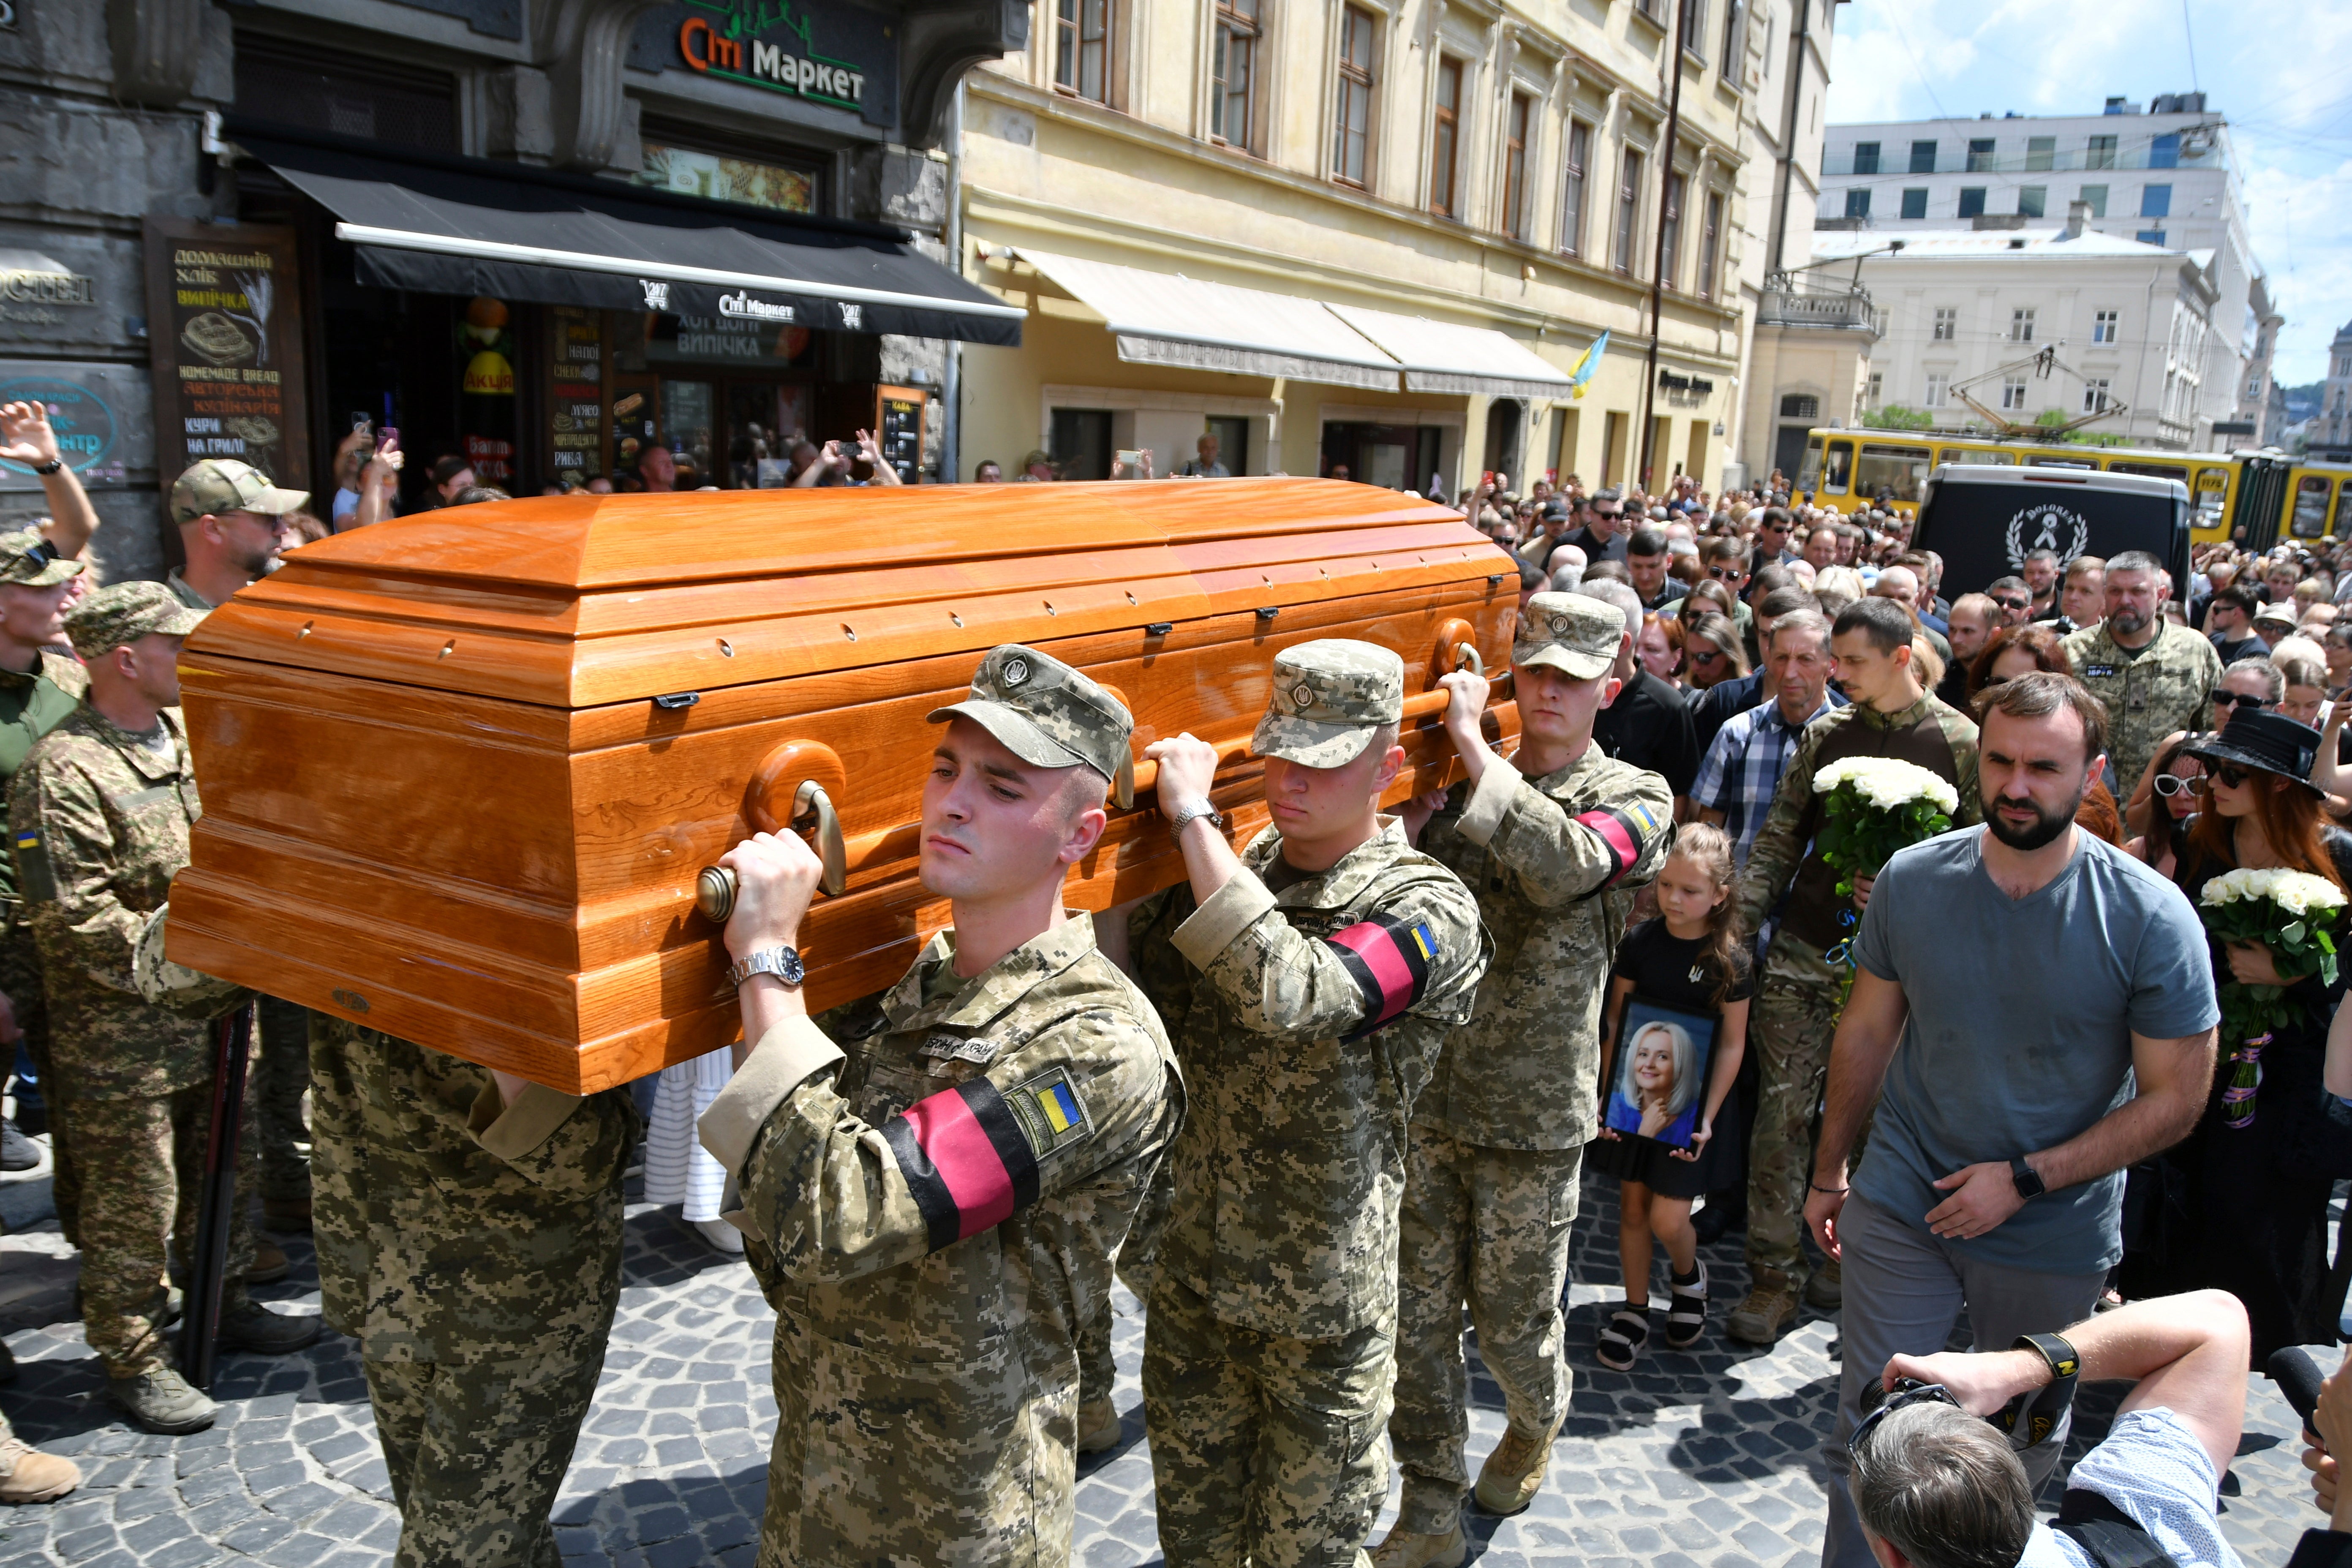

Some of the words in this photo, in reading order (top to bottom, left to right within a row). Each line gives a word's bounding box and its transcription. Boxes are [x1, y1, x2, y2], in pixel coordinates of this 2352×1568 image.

[681, 17, 741, 71] Сіті
[753, 39, 864, 101] Маркет
[174, 249, 272, 268] ДОМАШНІЙ
[176, 267, 218, 284] ХЛІБ
[177, 289, 250, 308] ВИПІЧКА
[746, 299, 793, 318] Маркет
[569, 343, 599, 359] НАПОЇ
[677, 332, 760, 356] ВИПІЧКА
[179, 365, 239, 380] HOMEMADE
[242, 368, 278, 383] BREAD
[553, 364, 580, 378] СНЕКИ
[183, 381, 280, 397] АВТОРСЬКА
[193, 397, 280, 415] КУЛІНАРІЯ
[892, 401, 910, 411] КАВА
[185, 417, 220, 434] КУРИ
[187, 438, 206, 453] НА
[207, 438, 246, 454] ГРИЛІ
[553, 433, 597, 447] МОРЕПРОДУКТИ
[554, 451, 583, 466] РИБА
[1332, 915, 1355, 926] КРАЇНИ
[925, 1037, 953, 1051] ЗБРОЙНІ
